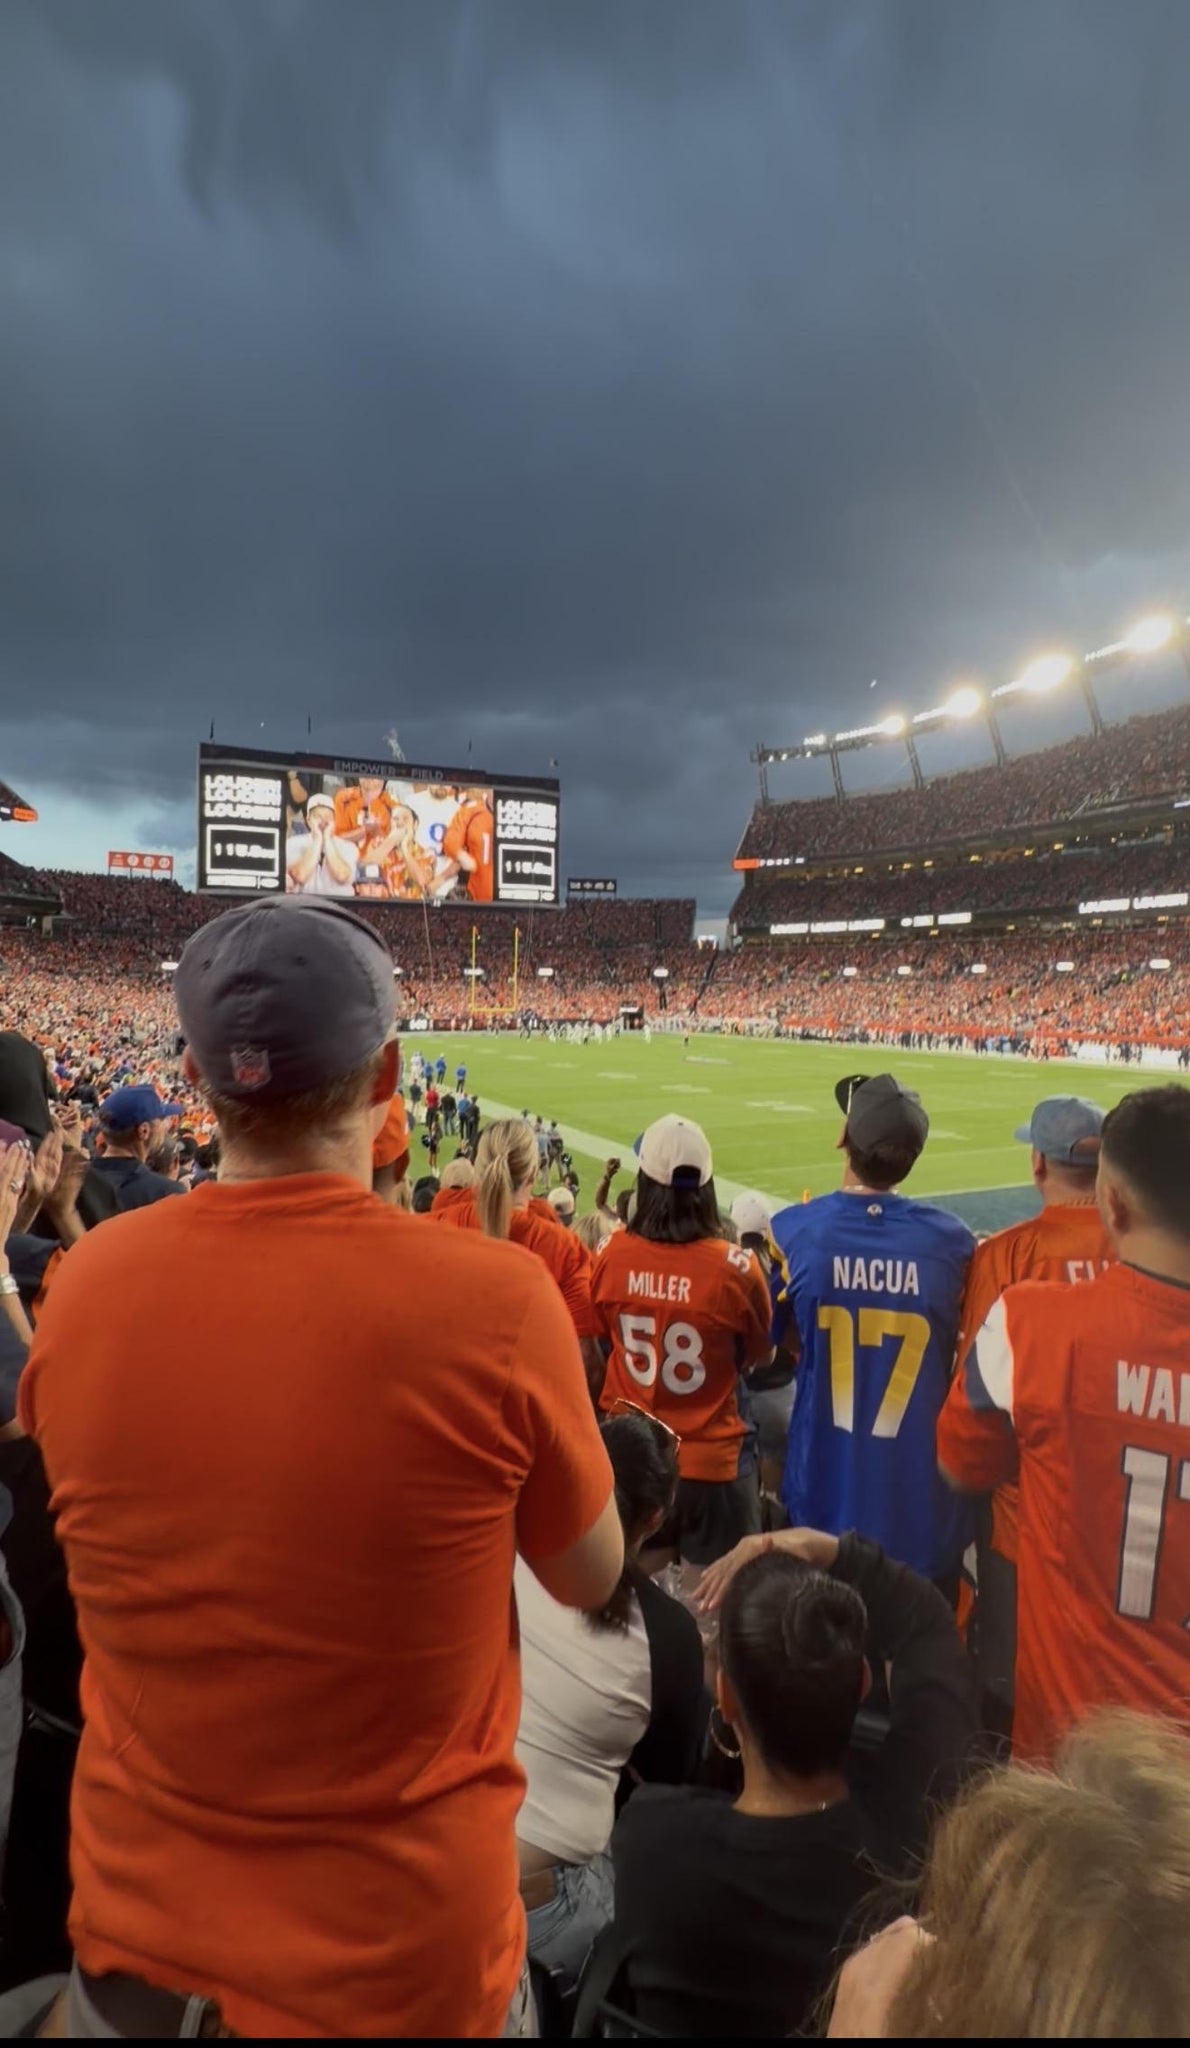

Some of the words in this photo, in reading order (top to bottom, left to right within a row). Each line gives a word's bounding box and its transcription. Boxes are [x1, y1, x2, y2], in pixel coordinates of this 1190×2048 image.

[334, 760, 396, 777] EMPOWER
[411, 768, 444, 780] FIELD
[628, 1269, 692, 1304] MILLER
[833, 1255, 919, 1296] NACUA
[618, 1312, 706, 1395] 58
[817, 1305, 931, 1438] 17
